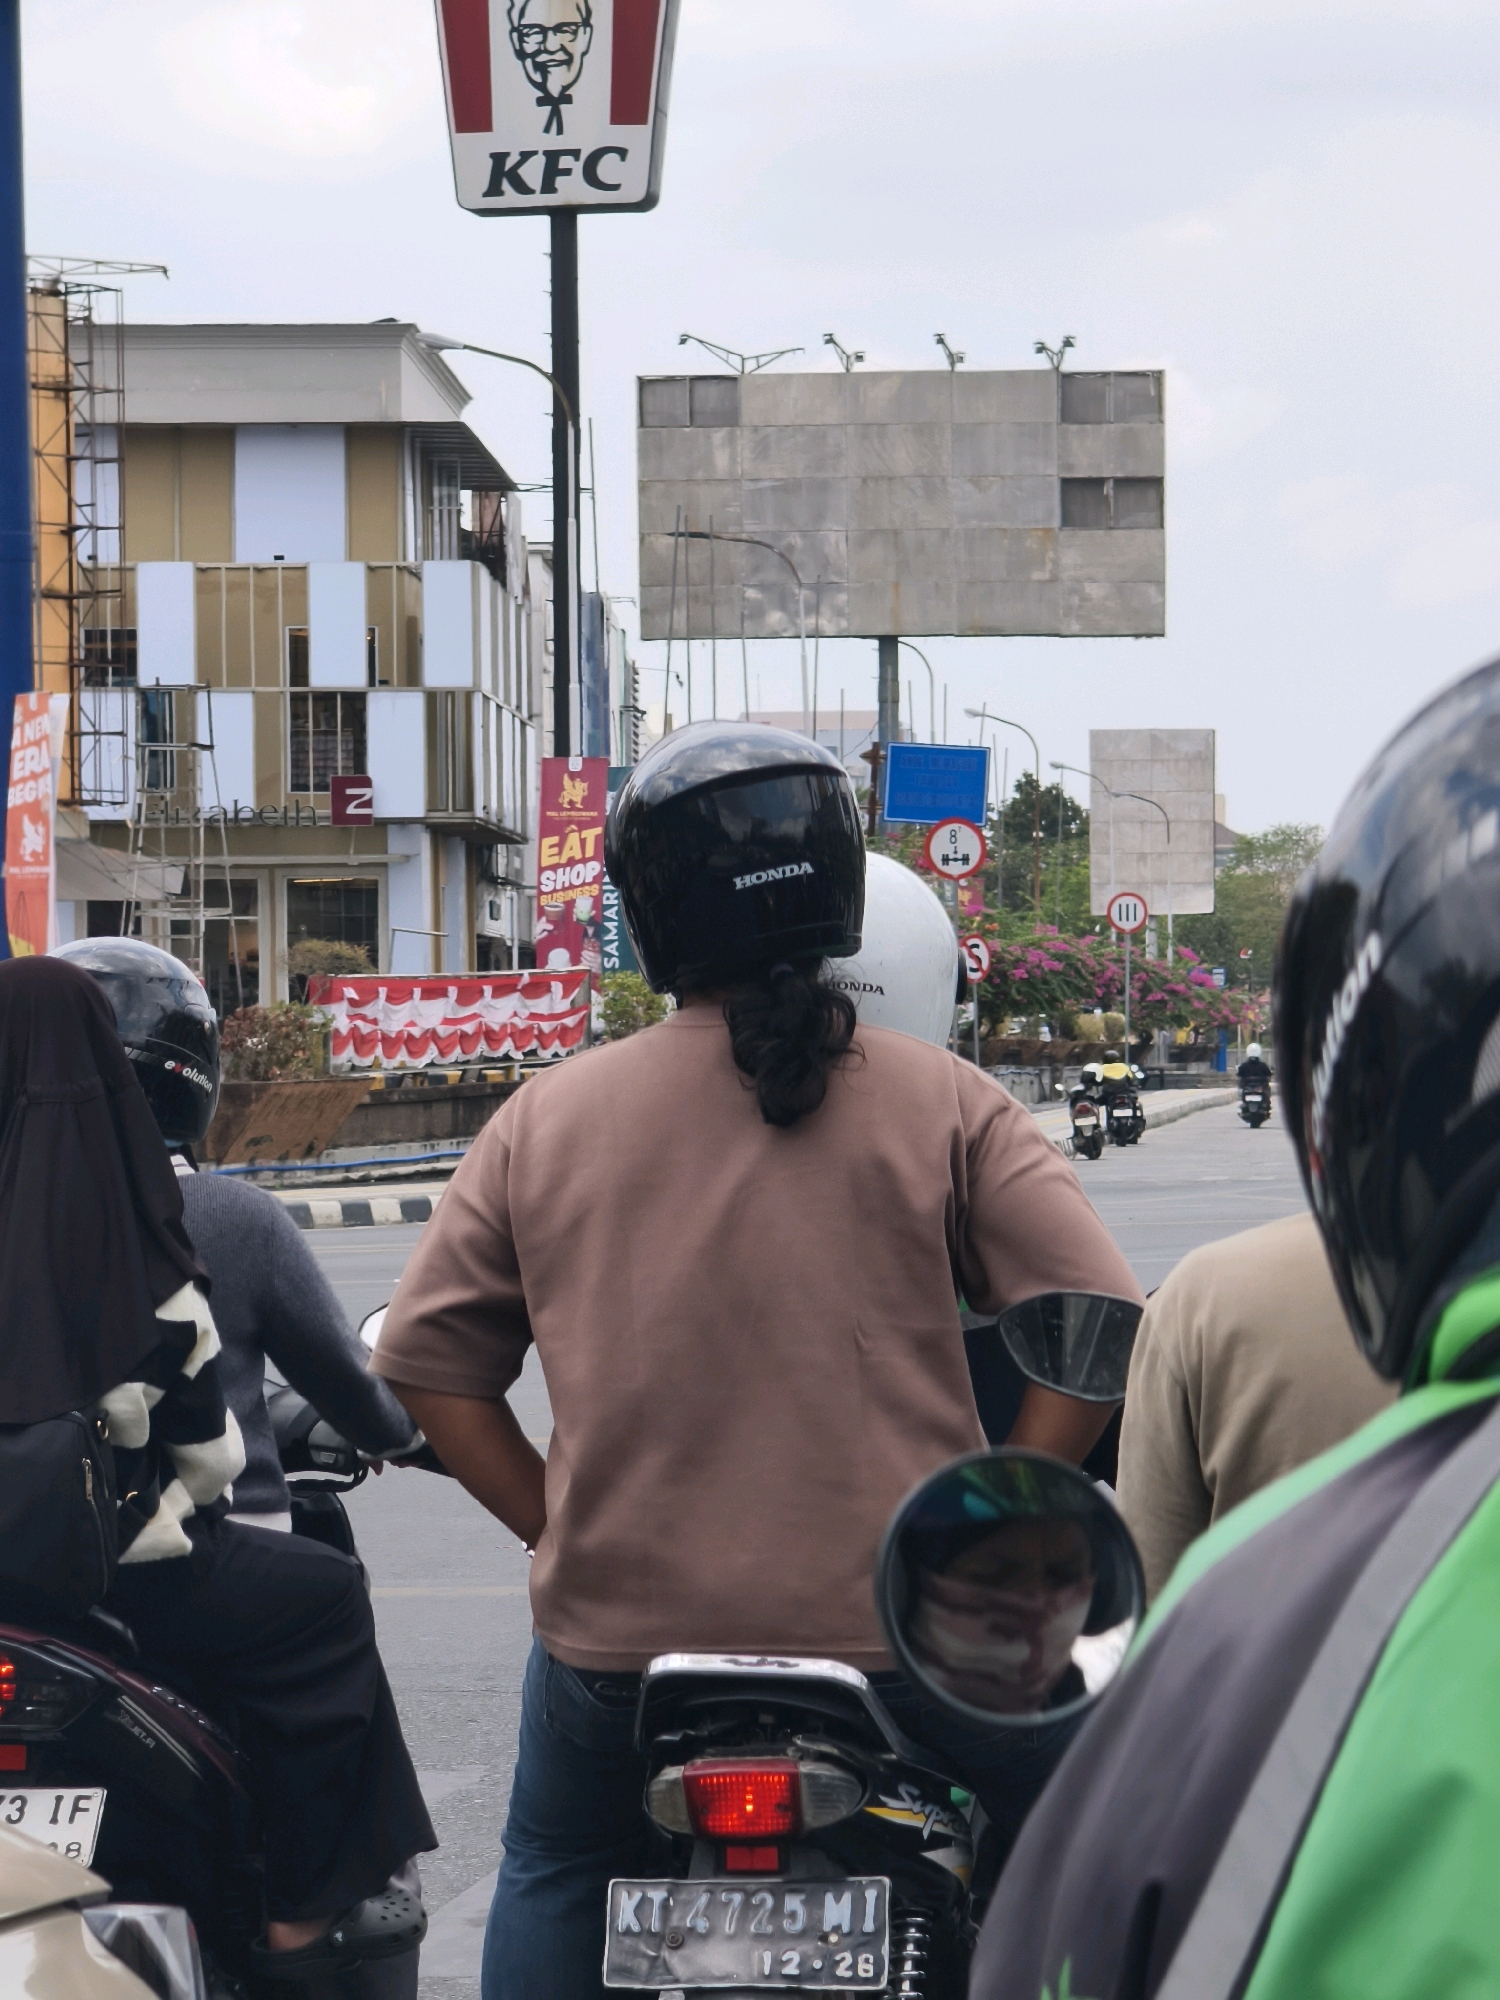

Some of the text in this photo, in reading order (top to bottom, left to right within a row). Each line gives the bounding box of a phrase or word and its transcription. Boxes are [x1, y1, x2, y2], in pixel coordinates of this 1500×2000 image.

[482, 146, 629, 198] KFC
[13, 740, 50, 781] ERA
[541, 826, 603, 867] EAT
[540, 861, 601, 892] SHOP
[733, 861, 814, 890] HONDA
[540, 884, 599, 906] BUSINESS
[164, 1060, 213, 1093] evolution
[0, 1794, 92, 1825] 3 IF
[618, 1889, 878, 1933] KT 4725 MI
